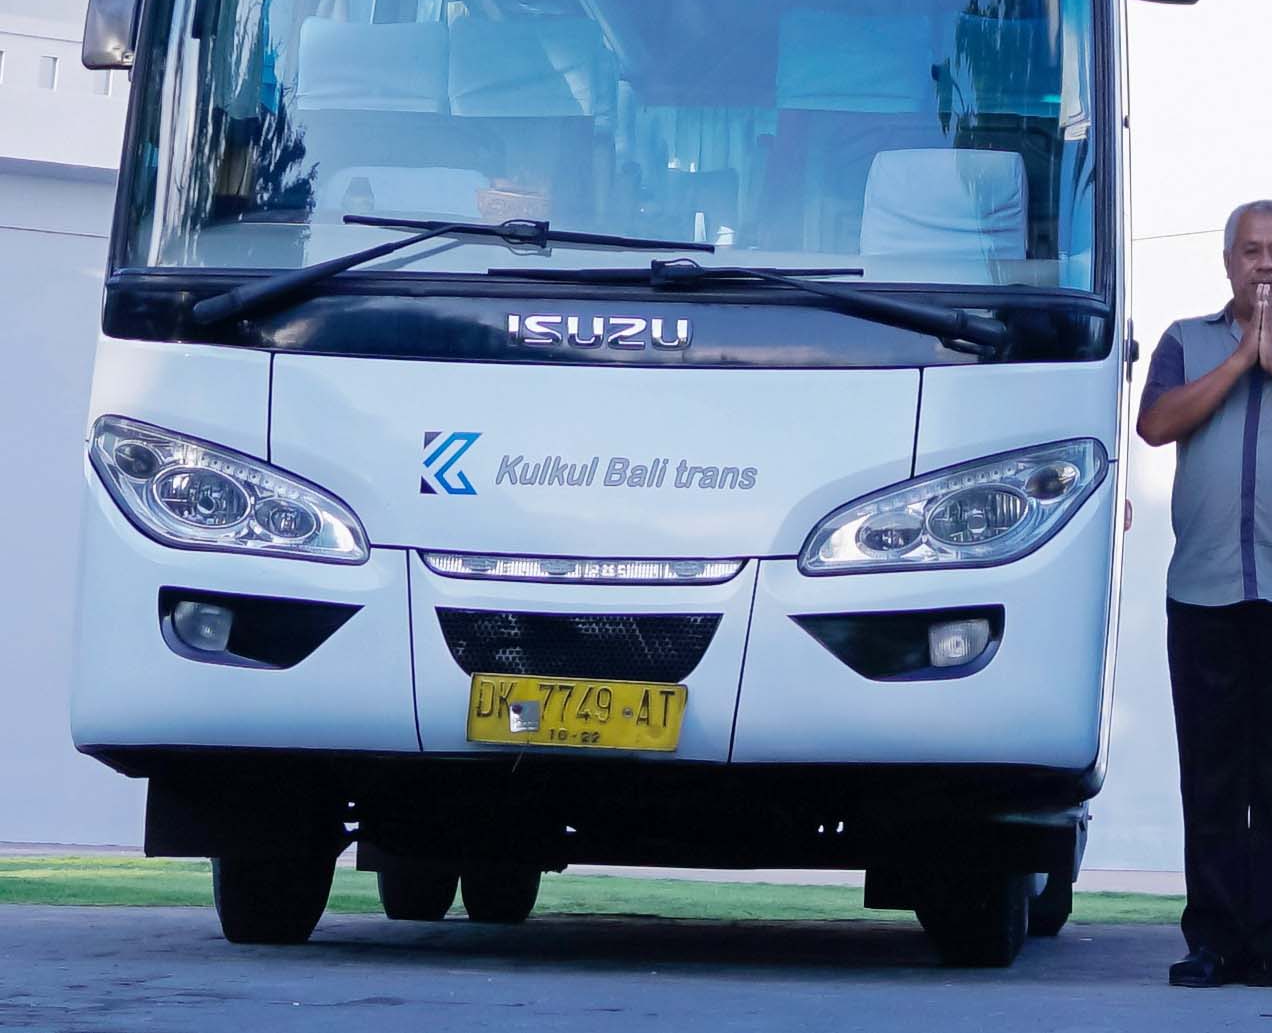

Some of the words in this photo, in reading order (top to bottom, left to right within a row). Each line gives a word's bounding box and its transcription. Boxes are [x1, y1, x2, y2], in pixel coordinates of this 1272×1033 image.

[506, 312, 693, 351] ISUZU
[495, 454, 599, 487] Kulkul
[603, 457, 666, 489] Bali
[674, 459, 758, 491] trans
[476, 679, 516, 720] DK
[538, 682, 613, 725] 7749
[635, 690, 676, 728] AT
